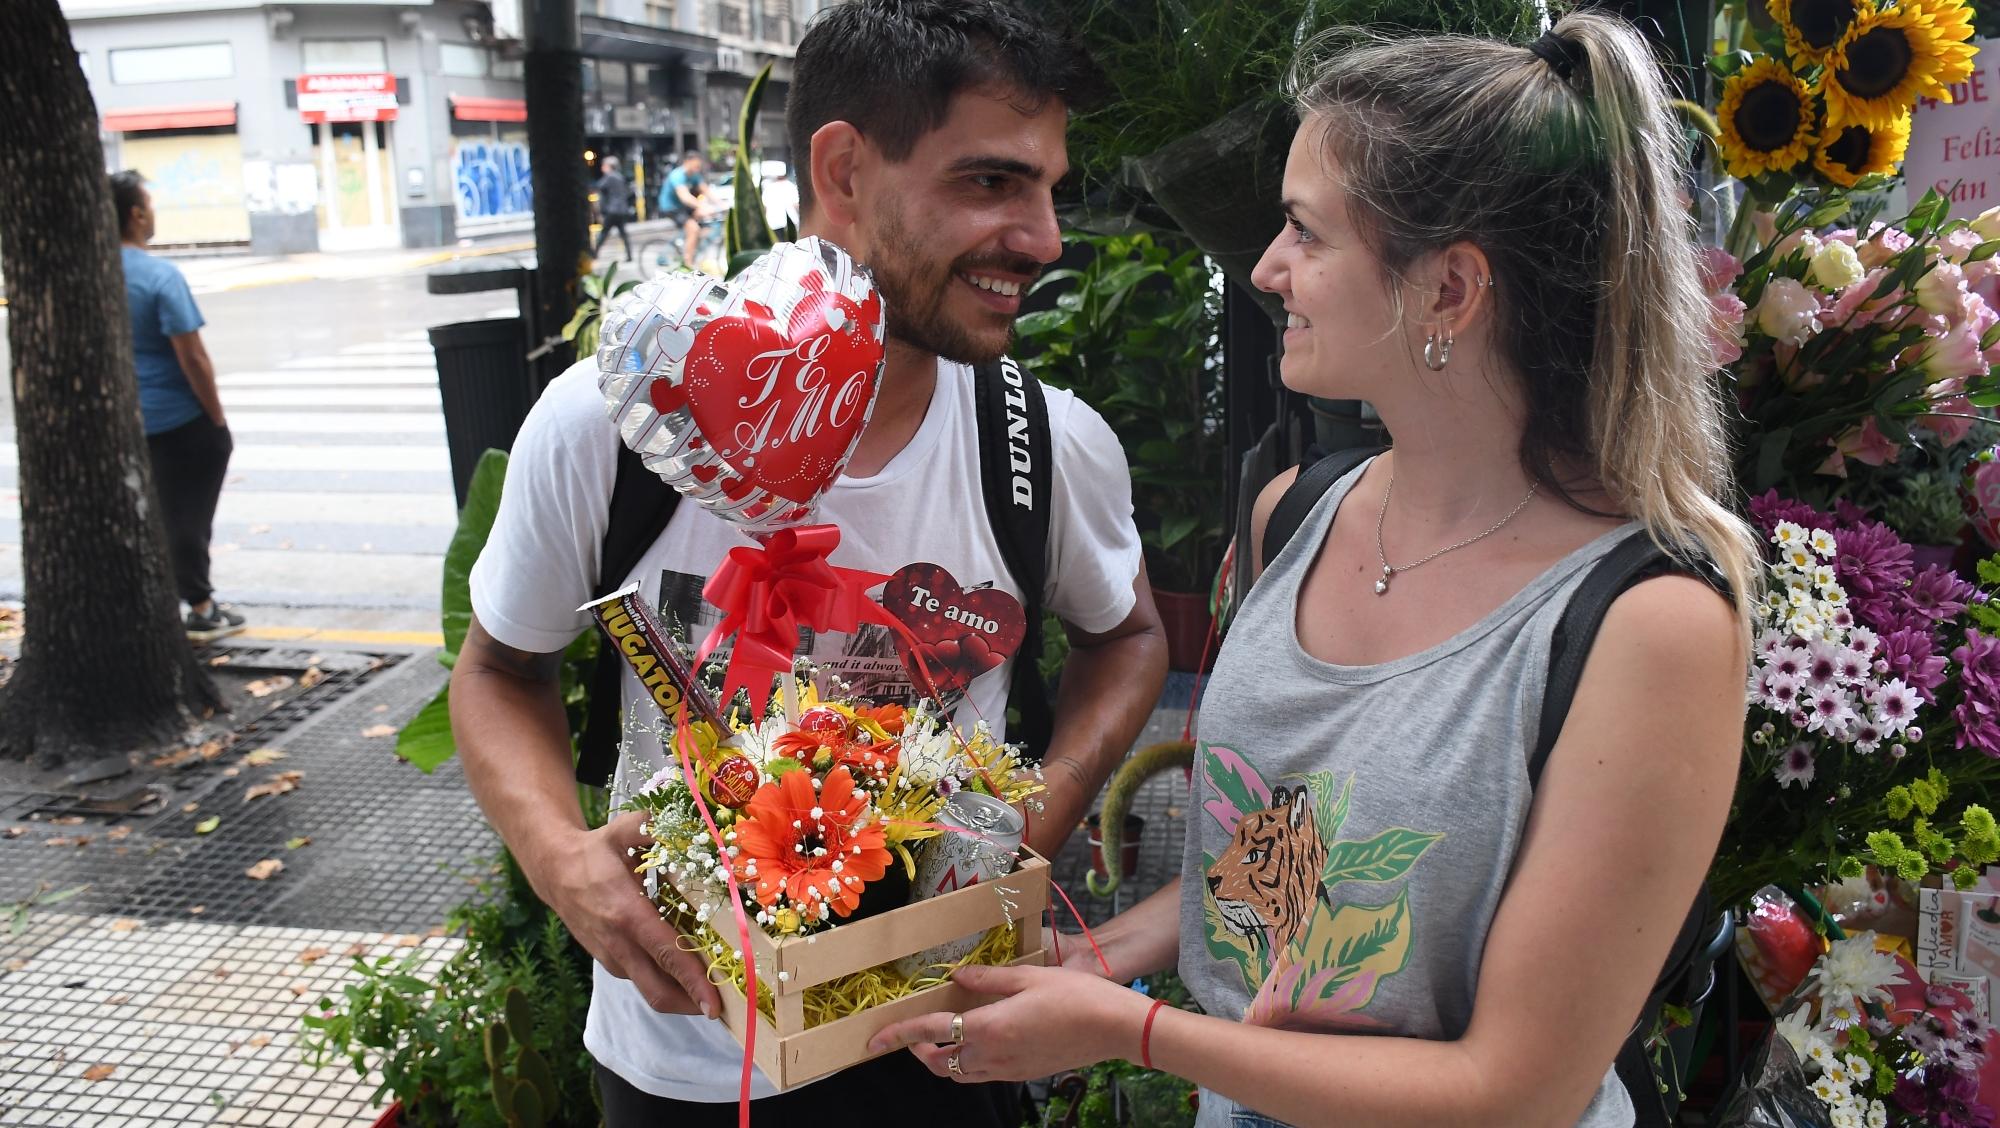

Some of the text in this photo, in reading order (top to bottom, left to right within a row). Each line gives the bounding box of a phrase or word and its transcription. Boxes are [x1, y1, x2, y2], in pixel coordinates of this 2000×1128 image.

[1950, 70, 1988, 106] DE
[1935, 178, 1987, 203] San
[738, 333, 831, 409] TE
[721, 370, 867, 459] AMO
[623, 594, 647, 632] onafide
[911, 586, 999, 634] Te amo
[600, 599, 695, 726] NUGATON
[708, 652, 729, 661] ork
[850, 660, 860, 670] it
[863, 660, 903, 673] alway
